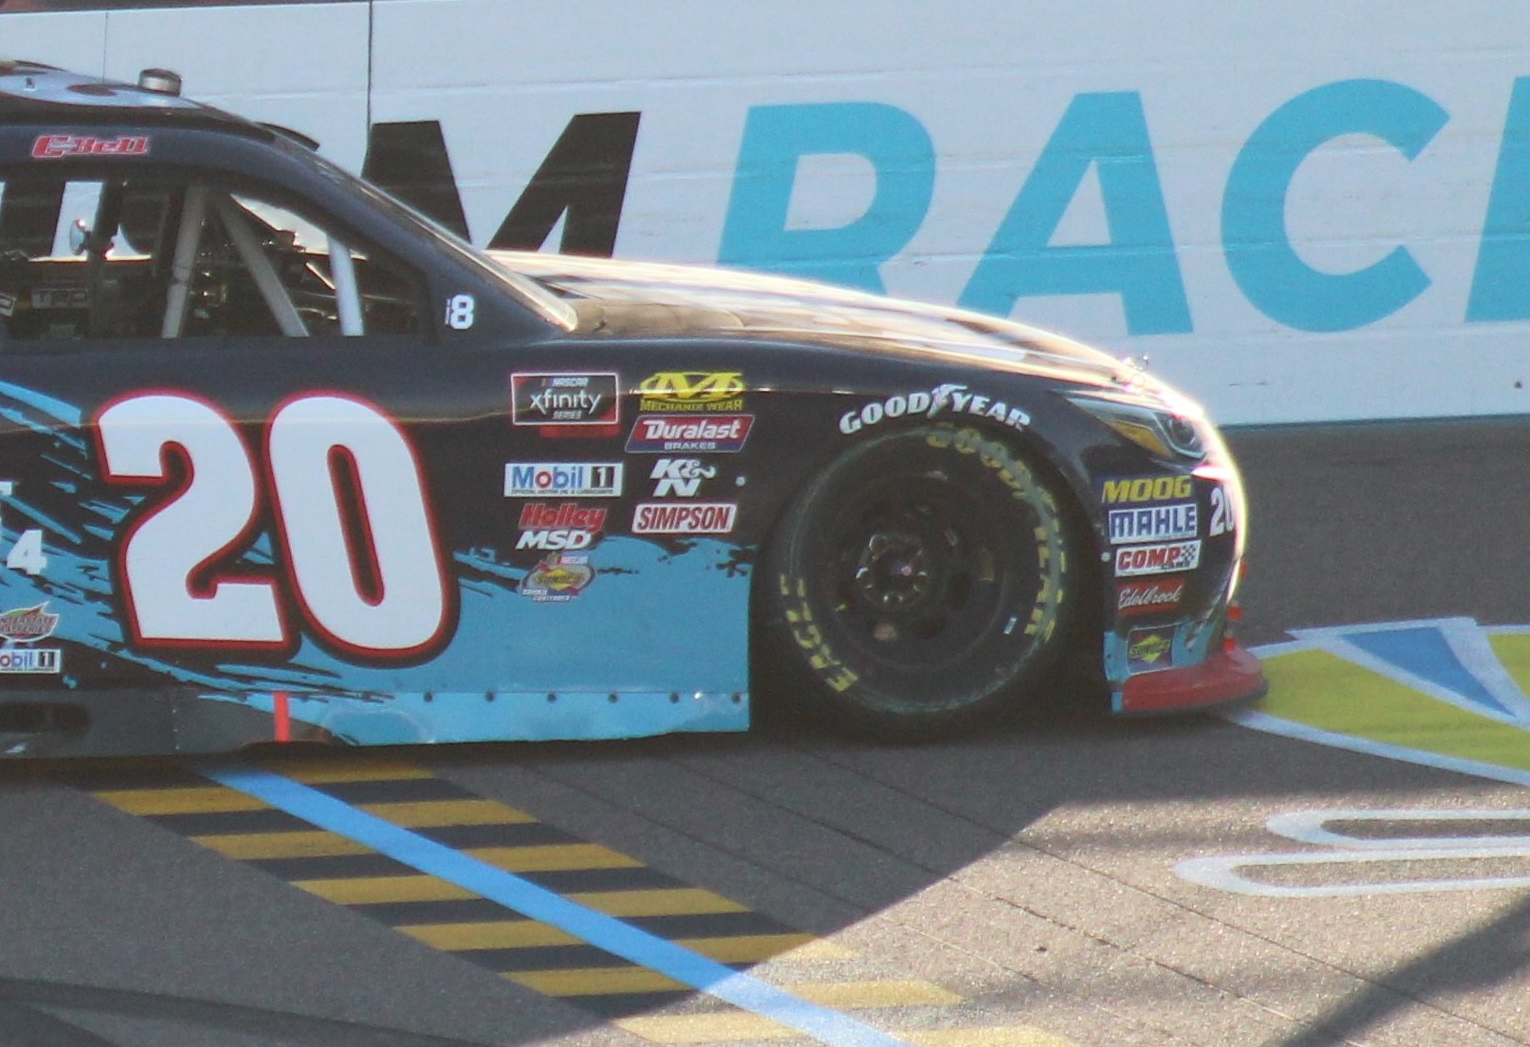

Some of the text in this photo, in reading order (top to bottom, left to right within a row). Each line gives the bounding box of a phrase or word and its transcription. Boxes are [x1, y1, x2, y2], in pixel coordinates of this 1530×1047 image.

[450, 294, 475, 330] 8
[530, 388, 602, 415] xfinity
[838, 384, 1032, 436] GOODYEAR
[552, 410, 582, 420] SERIES
[643, 420, 741, 440] Duralast
[663, 441, 716, 450] BRAKES
[512, 465, 583, 489] Mobil
[1102, 475, 1191, 503] MOOG
[93, 389, 452, 656] 20
[519, 503, 607, 533] Holley
[638, 506, 729, 530] SIMPSON
[1110, 505, 1196, 538] MAHLE
[7, 529, 48, 575] 4
[515, 530, 592, 550] MSD
[1117, 546, 1183, 570] COMP
[1118, 585, 1184, 610] Edelbrock
